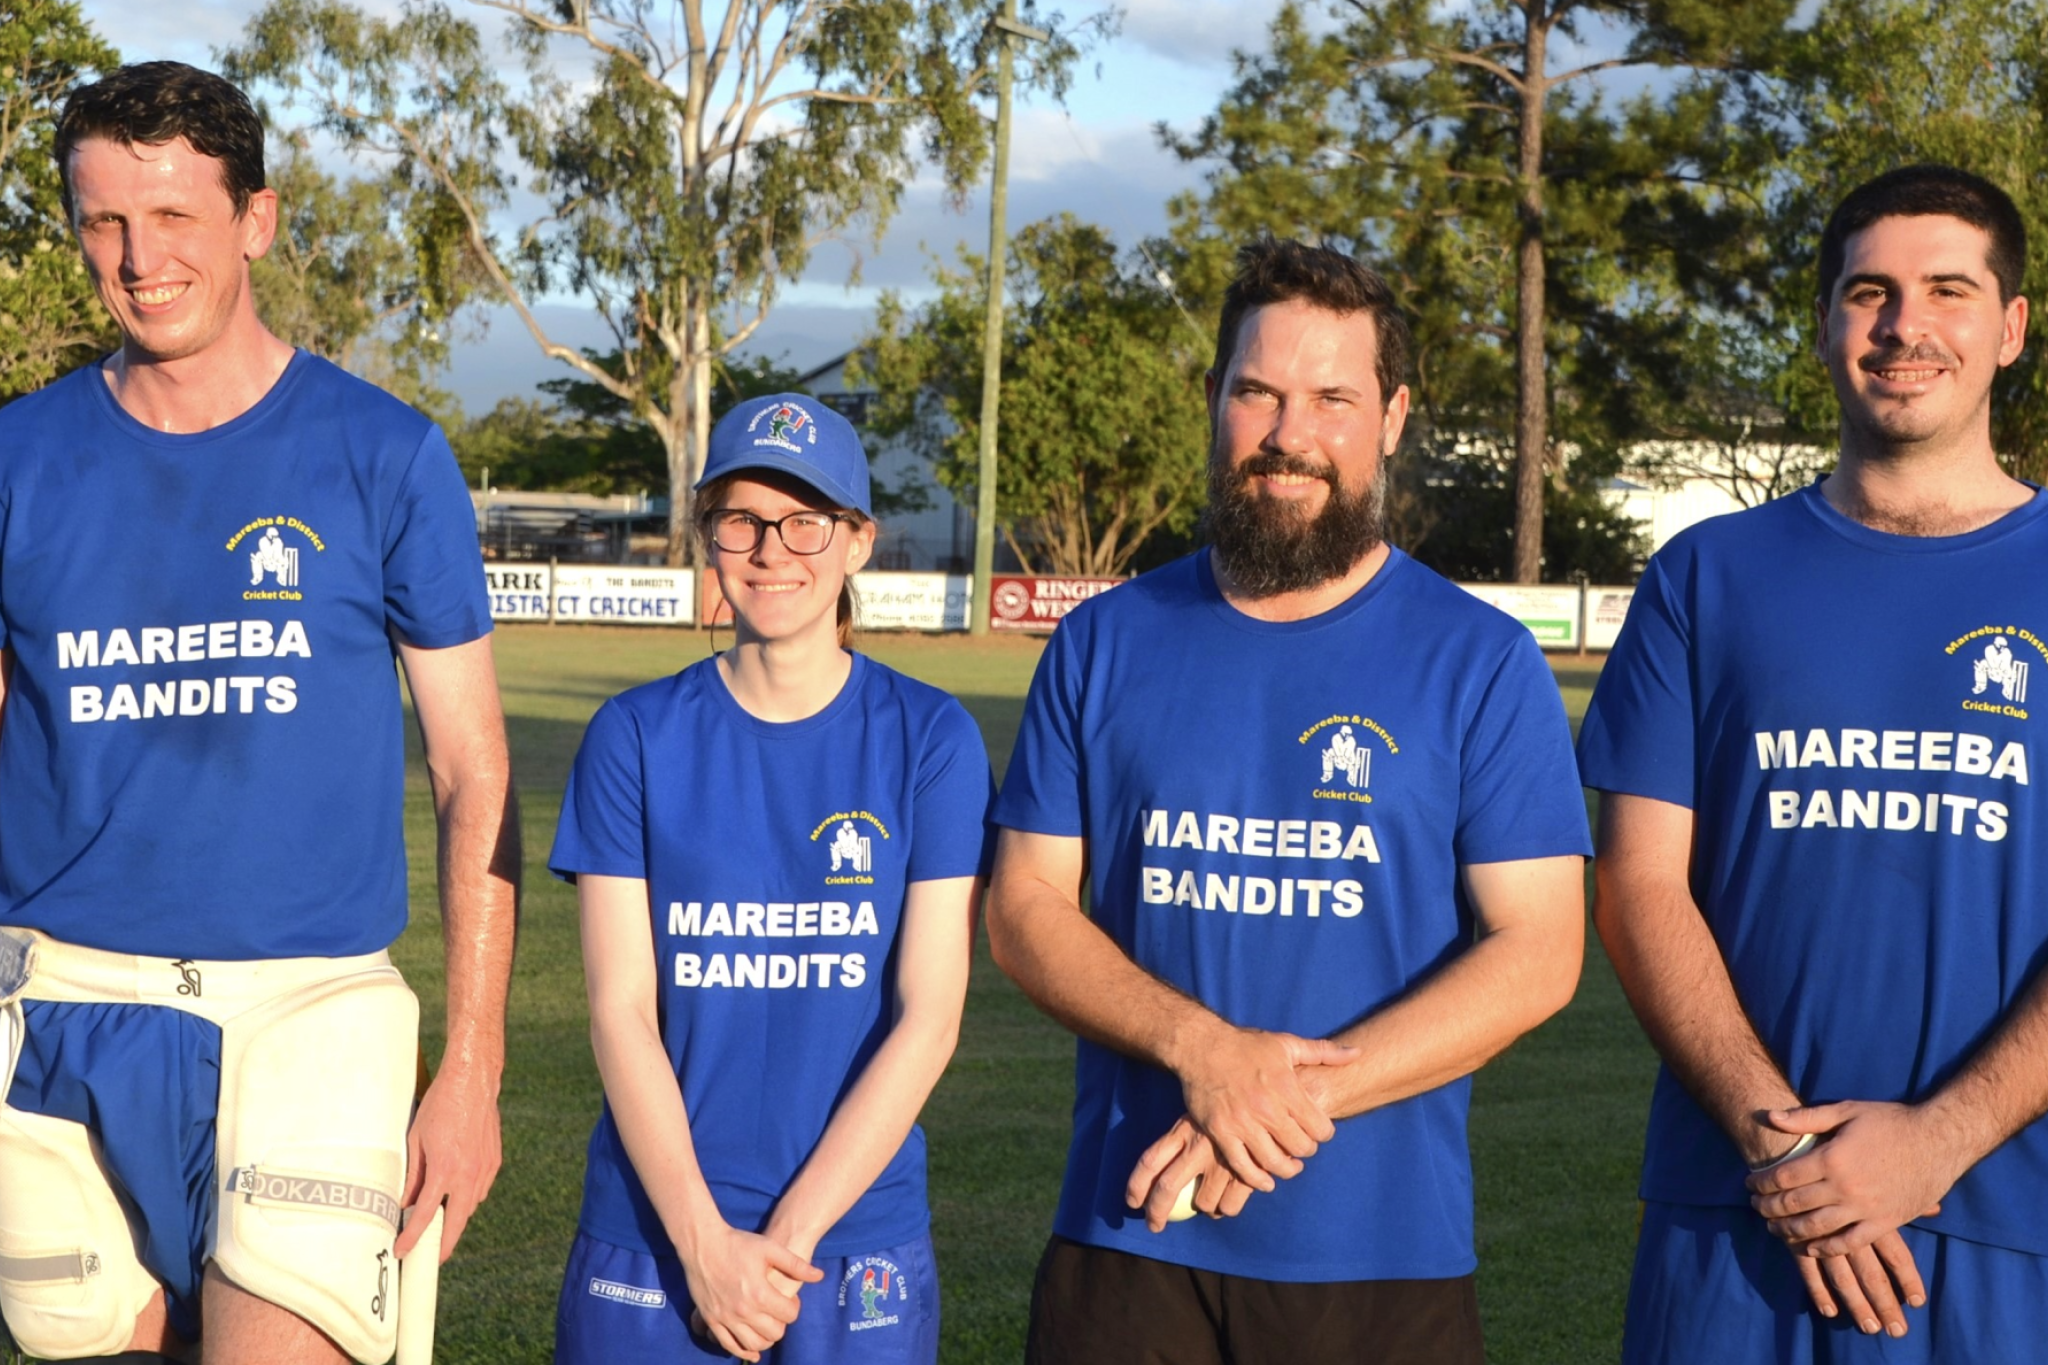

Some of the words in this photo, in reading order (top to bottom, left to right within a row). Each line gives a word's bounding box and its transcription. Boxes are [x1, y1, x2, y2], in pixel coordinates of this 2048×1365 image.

[782, 401, 814, 424] CRICKET
[807, 425, 817, 445] CLUB
[753, 438, 802, 454] BUNDABERG
[226, 517, 274, 552] Mareeba
[275, 515, 286, 526] &
[286, 516, 326, 552] District
[243, 590, 278, 601] Cricket
[279, 590, 303, 601] Club
[630, 578, 675, 588] BANDITS
[1035, 580, 1122, 599] RINGER
[589, 596, 680, 617] CRICKET
[1030, 600, 1083, 618] WES
[57, 620, 311, 669] MAREEBA
[1944, 625, 2003, 655] Mareeba
[2006, 625, 2016, 636] &
[70, 676, 298, 723] BANDITS
[1962, 699, 2001, 714] Cricket
[2003, 704, 2029, 720] Club
[1298, 714, 1349, 745] Mareeba
[1351, 714, 1361, 725] &
[1362, 717, 1400, 755] District
[1755, 728, 2029, 786] MAREEBA
[1312, 788, 1347, 801] Cricket
[1348, 792, 1373, 804] Club
[810, 812, 849, 842] Mareeba
[851, 810, 859, 819] &
[859, 810, 890, 841] District
[1768, 789, 2009, 842] BANDITS
[1141, 809, 1381, 864] MAREEBA
[825, 876, 854, 885] Cricket
[855, 875, 874, 885] Club
[1142, 866, 1364, 918] BANDITS
[668, 901, 879, 937] MAREEBA
[675, 952, 867, 989] BANDITS
[592, 1281, 664, 1305] STORMERS
[838, 1261, 864, 1306] BROTHERS
[865, 1257, 899, 1275] CRICKET
[896, 1275, 908, 1301] CLUB
[849, 1314, 899, 1331] BUNDABERG
